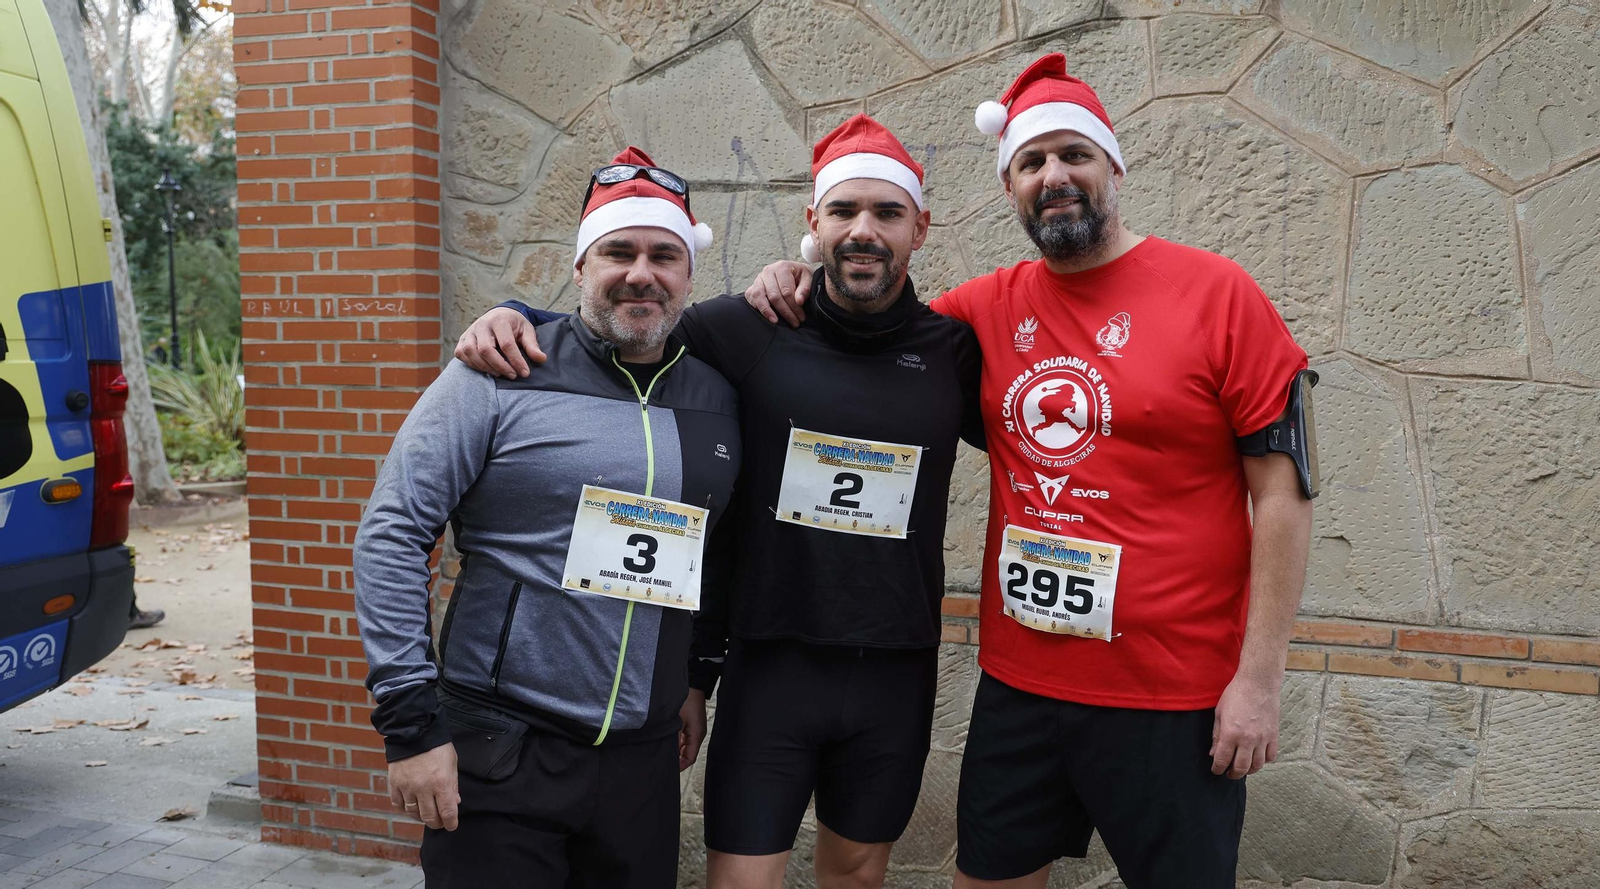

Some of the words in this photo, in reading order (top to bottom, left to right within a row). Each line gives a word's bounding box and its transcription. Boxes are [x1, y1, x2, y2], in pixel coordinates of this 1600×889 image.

[1014, 333, 1035, 343] UCA
[1033, 356, 1088, 373] SOLIDARIA
[1087, 367, 1103, 384] DE
[1002, 369, 1033, 418] CARRERA
[1097, 382, 1112, 437] NAVIDAD
[1004, 420, 1016, 433] XI
[793, 441, 813, 449] EVOS
[813, 442, 855, 461] CARRERA
[857, 450, 895, 467] NAVIDAD
[1018, 441, 1041, 464] CIUDAD
[1041, 458, 1052, 467] DE
[1053, 443, 1096, 468] ALGECIRAS
[864, 464, 893, 474] ALGECIRAS
[829, 472, 864, 509] 2
[1070, 488, 1110, 499] EVOS
[584, 500, 606, 508] EVOS
[643, 500, 667, 510] EDICIÓN
[814, 504, 833, 514] ABADIA
[852, 509, 873, 519] CRISTIAN
[606, 500, 651, 522] CARRERA
[652, 510, 688, 530] NAVIDAD
[1024, 506, 1084, 523] CUPRA
[660, 526, 685, 537] ALGECIRAS
[622, 533, 659, 574] 3
[1020, 539, 1051, 560] CARRERA
[1053, 546, 1091, 566] NAVIDAD
[1060, 562, 1089, 573] ALGECIRAS
[599, 569, 619, 579] ABADÍA
[620, 572, 638, 583] REGEN,
[639, 576, 652, 585] JOSÉ
[653, 578, 672, 588] MANUEL
[1007, 562, 1095, 615] 295
[1021, 603, 1035, 613] MIGUEL
[1036, 606, 1051, 618] RUBIO,
[1052, 610, 1071, 621] ANDRÉS
[41, 656, 54, 667] SGS
[3, 669, 17, 680] SGS
